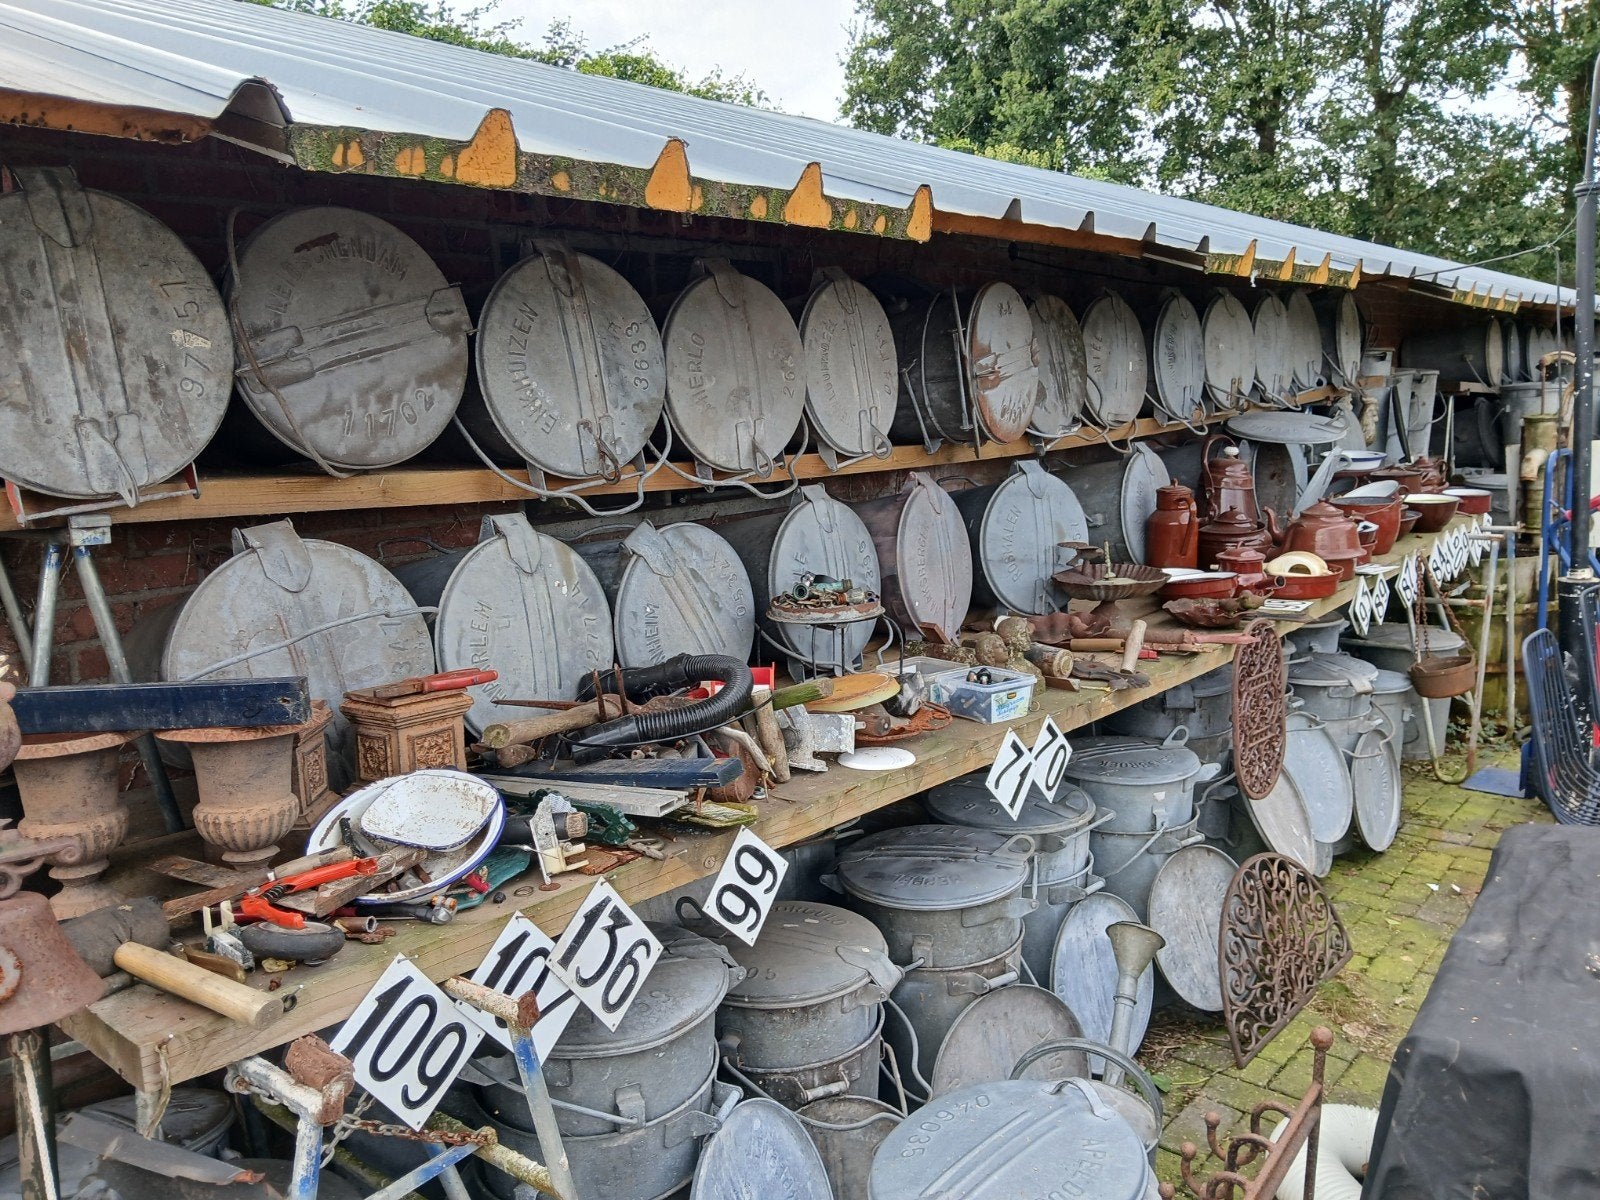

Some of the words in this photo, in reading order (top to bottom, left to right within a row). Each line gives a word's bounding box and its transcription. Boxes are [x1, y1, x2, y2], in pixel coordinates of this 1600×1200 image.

[507, 300, 558, 436] ENKHUIZEN
[624, 320, 650, 392] 3633
[1001, 504, 1022, 583] ROSMALEN
[994, 739, 1033, 811] 71
[1033, 722, 1067, 792] 70
[716, 844, 778, 934] 99
[556, 895, 652, 1014] 136
[341, 975, 467, 1110] 109
